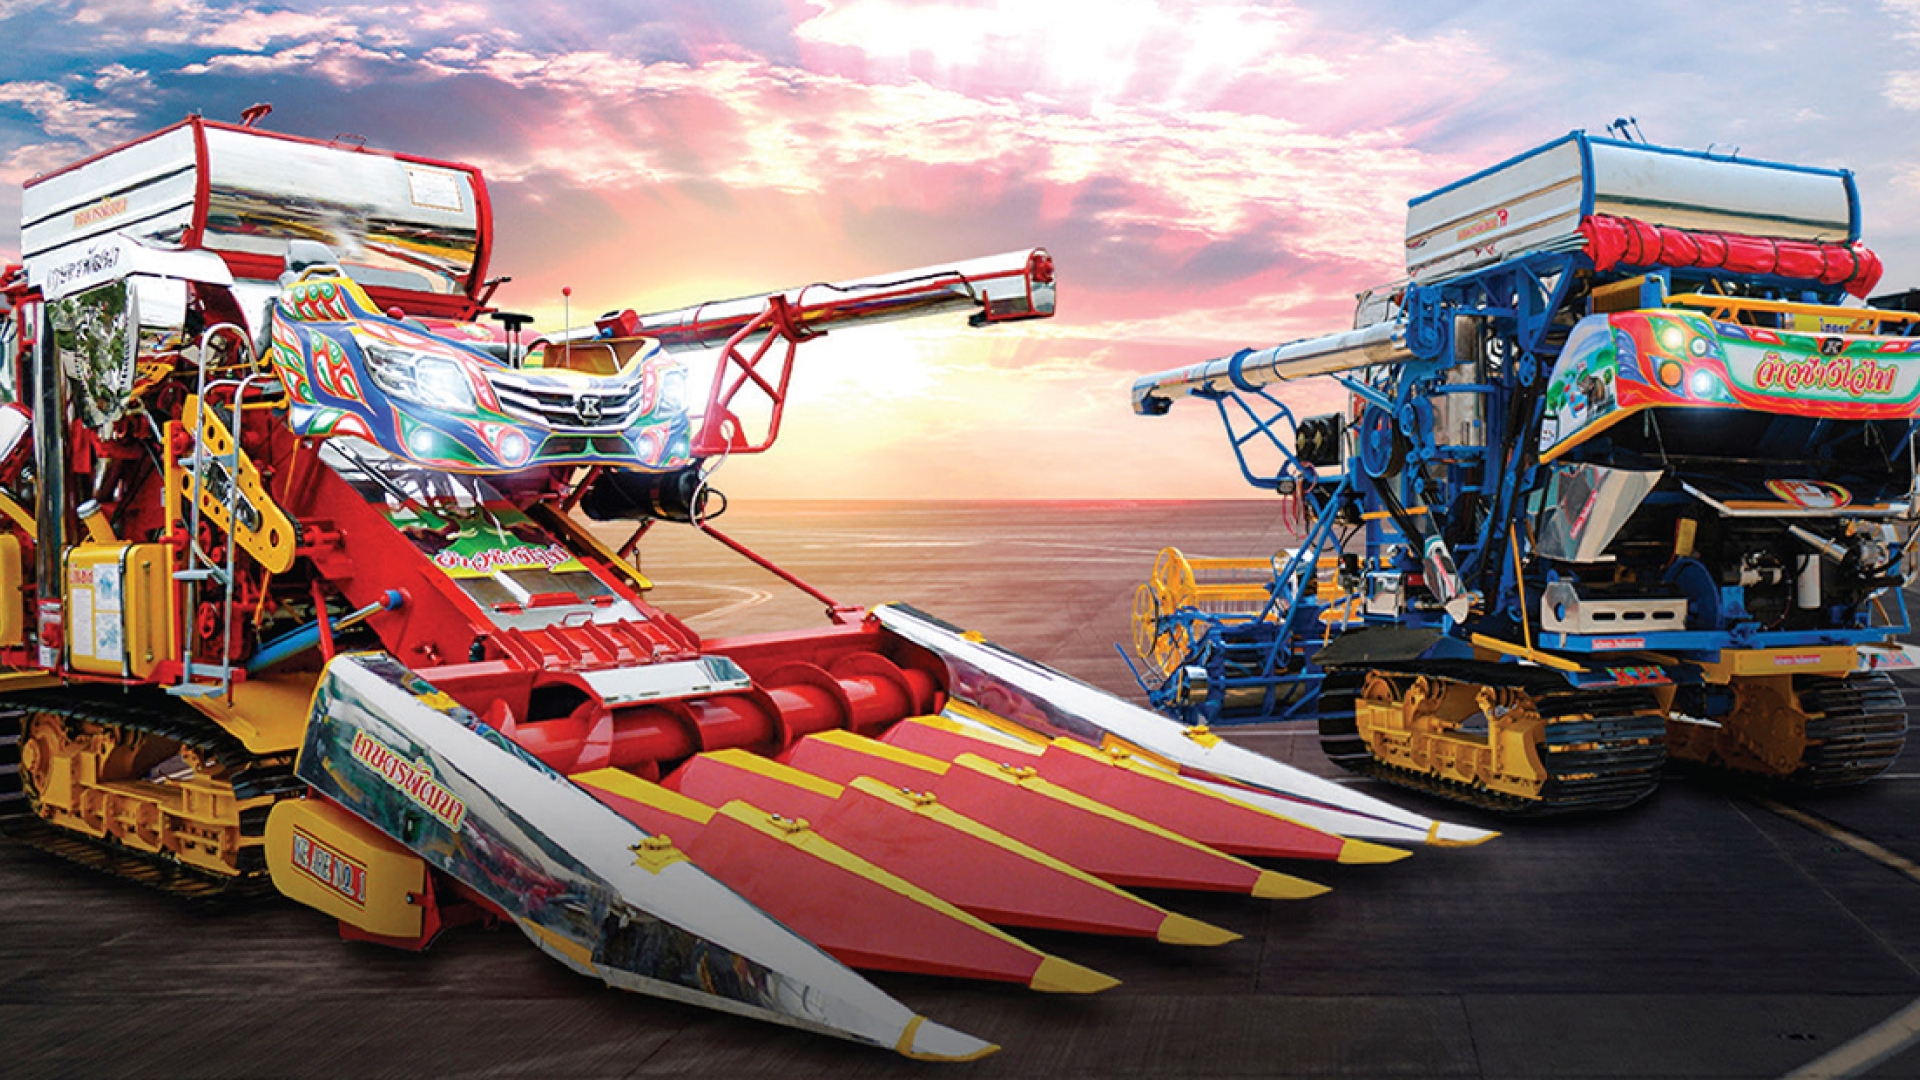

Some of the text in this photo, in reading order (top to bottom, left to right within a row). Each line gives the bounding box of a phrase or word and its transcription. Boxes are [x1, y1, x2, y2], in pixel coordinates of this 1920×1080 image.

[581, 398, 600, 415] K
[352, 731, 465, 828] เกษตรพัฒนา
